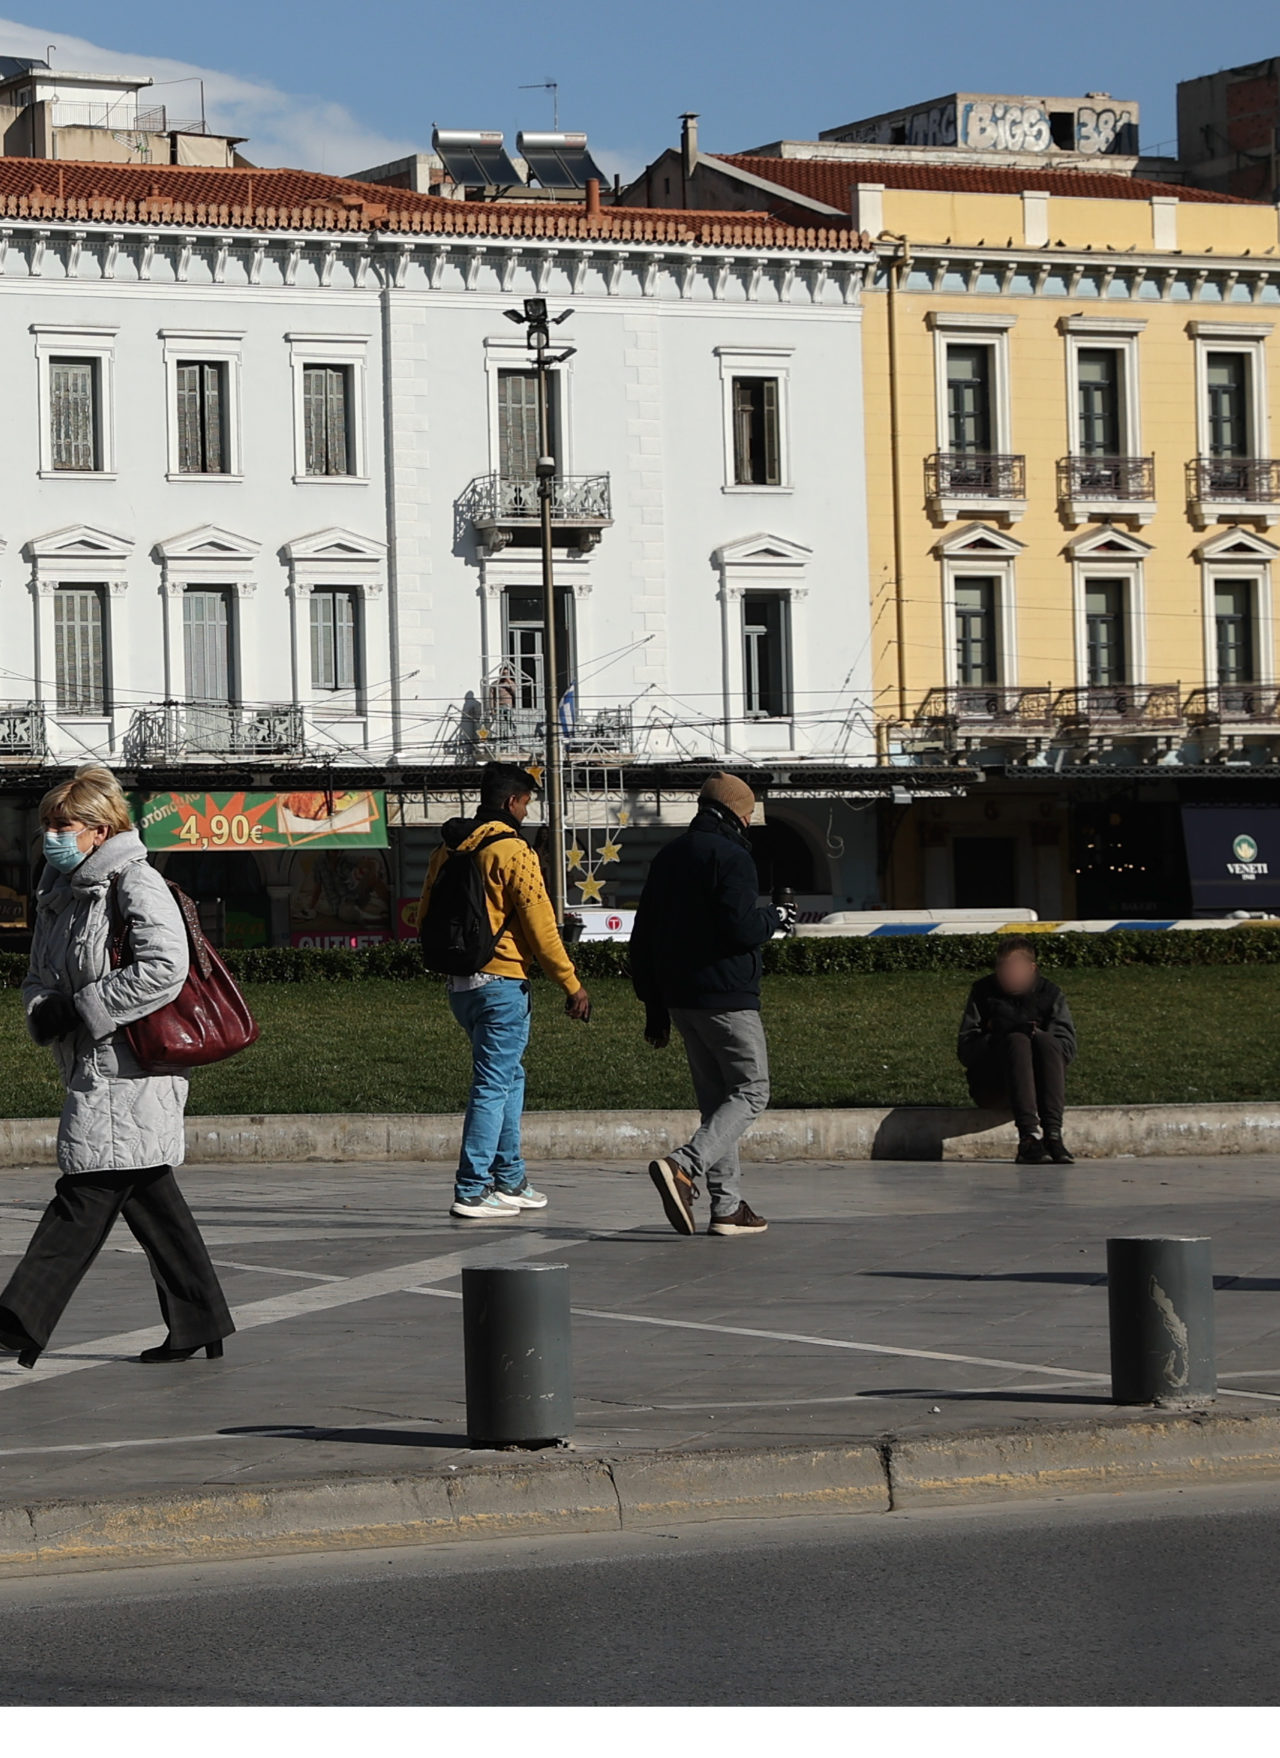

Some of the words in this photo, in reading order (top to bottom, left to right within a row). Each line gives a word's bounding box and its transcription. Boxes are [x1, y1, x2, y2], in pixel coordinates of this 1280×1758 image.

[139, 792, 201, 829] οτόπουλο
[179, 813, 264, 850] 4,90€
[1226, 863, 1269, 874] VENETI
